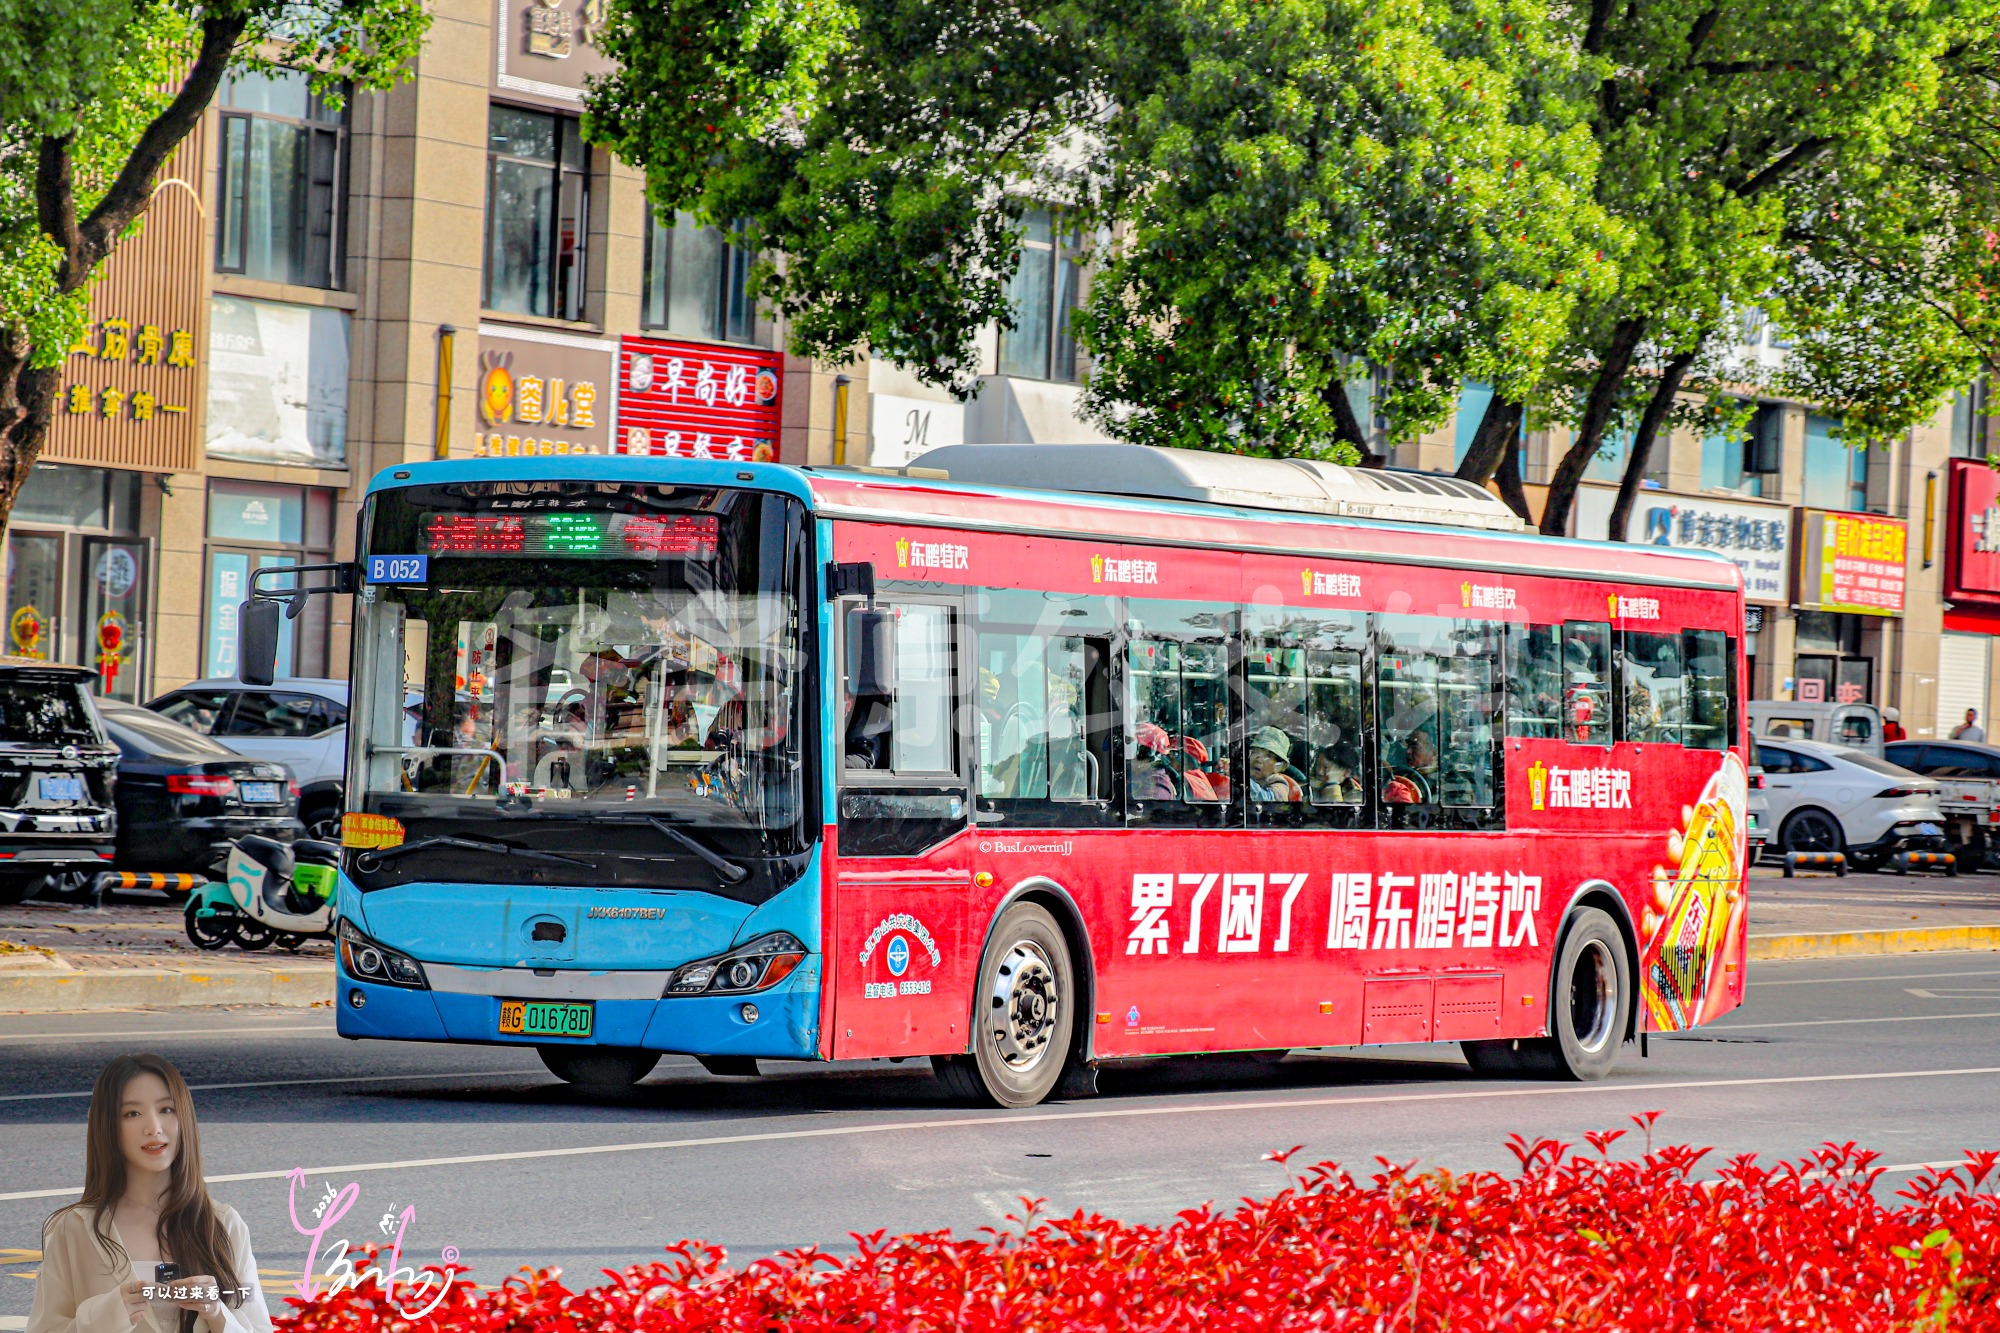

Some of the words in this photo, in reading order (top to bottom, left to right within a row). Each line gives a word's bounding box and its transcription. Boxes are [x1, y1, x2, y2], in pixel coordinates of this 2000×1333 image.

[661, 357, 749, 407] 早尚好
[374, 560, 385, 579] B
[389, 559, 420, 579] 052
[910, 542, 969, 571] 东鹏特饮
[1104, 557, 1158, 585] 东鹏特饮
[1313, 570, 1362, 597] 东鹏特饮
[1471, 584, 1516, 609] 东鹏特饮
[1617, 595, 1660, 620] 东鹏特饮
[1549, 766, 1632, 809] 东鹏特饮
[587, 907, 667, 920] JXK6107BEV
[1126, 873, 1309, 956] 累了困了
[1326, 870, 1542, 951] 喝东鹏特饮
[859, 912, 942, 968] 九江市公共交通集团公司
[900, 980, 931, 995] 8553416
[529, 1007, 589, 1031] 01678D
